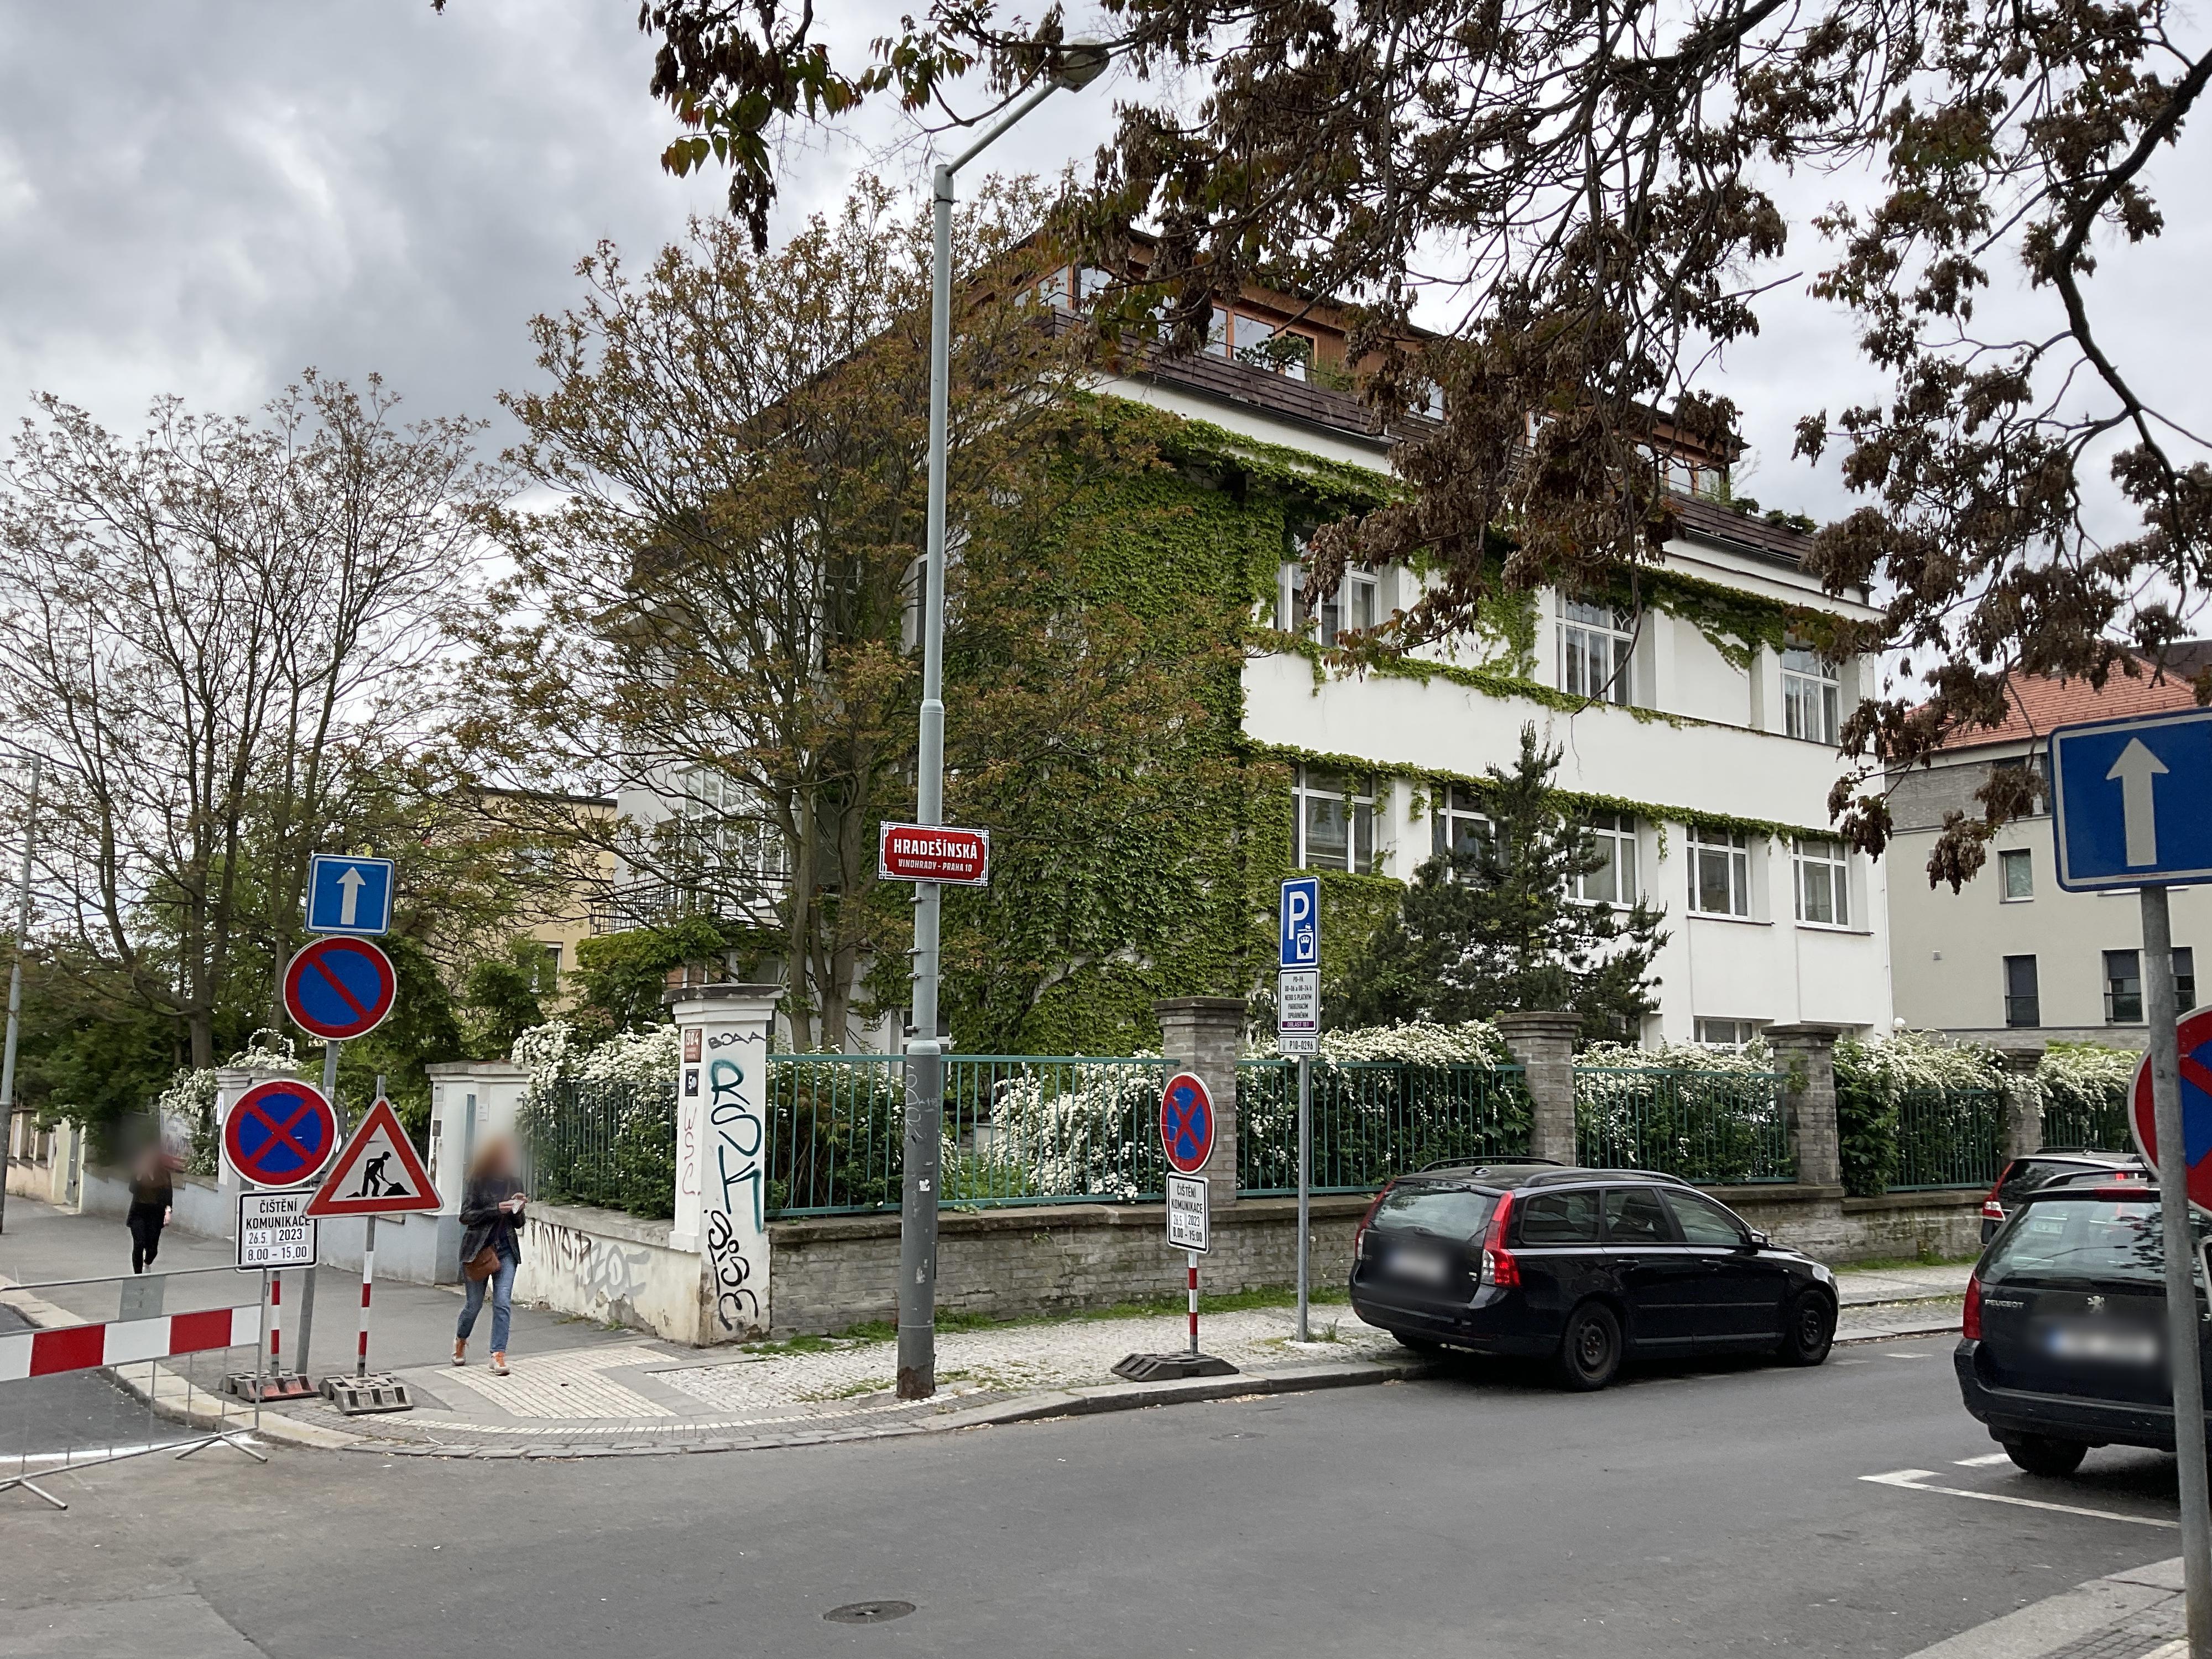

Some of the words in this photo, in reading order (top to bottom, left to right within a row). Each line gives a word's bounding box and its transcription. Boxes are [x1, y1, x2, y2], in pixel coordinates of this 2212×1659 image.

[894, 838, 978, 859] HRADEŠÍNSKÁ
[898, 859, 937, 870] VINOHRADY
[942, 862, 964, 872] PRAHA
[965, 864, 972, 872] 10
[1288, 891, 1309, 940] P
[685, 1032, 700, 1046] 1984
[1289, 1040, 1313, 1050] P10-0296
[1177, 1182, 1196, 1198] ČIŠTĚNÍ
[260, 1198, 298, 1213] ČIŠTĚNÍ
[1171, 1198, 1203, 1214] KOMUNIKACE
[246, 1215, 310, 1229] KOMUNIKACE
[1188, 1214, 1200, 1227] 2023
[249, 1232, 268, 1244] 26.5.
[279, 1228, 302, 1241] 2023
[248, 1248, 268, 1261] 8.00
[1985, 1299, 2025, 1308] PEUGEOT
